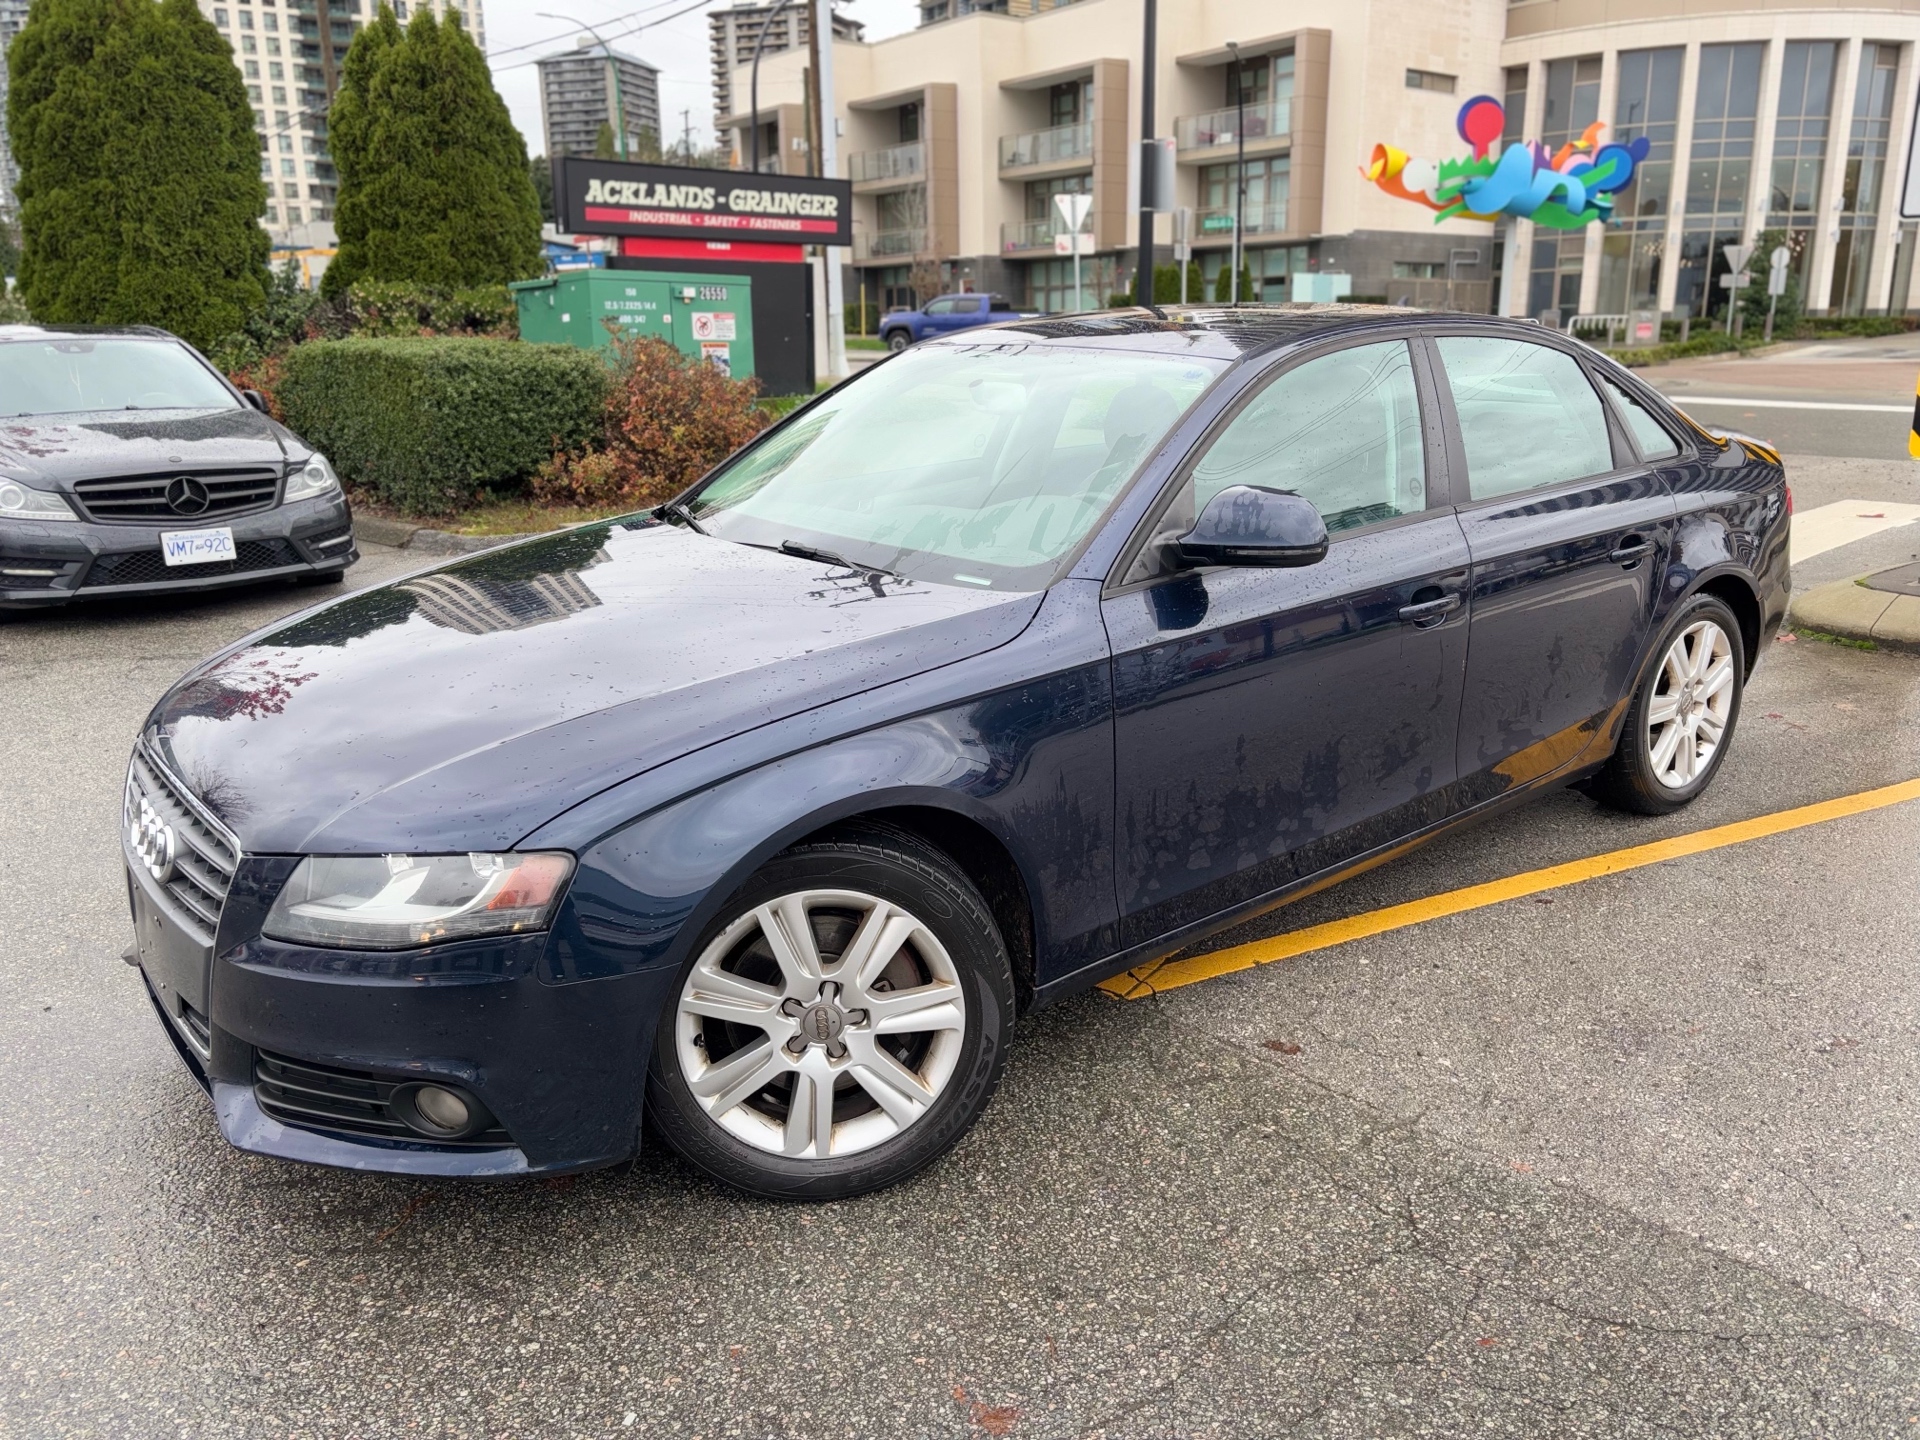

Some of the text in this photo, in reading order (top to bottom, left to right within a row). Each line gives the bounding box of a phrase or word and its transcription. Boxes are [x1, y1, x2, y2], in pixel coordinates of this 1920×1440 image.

[629, 211, 802, 231] INDUSTRIAL SAFETY FASTENERS
[699, 286, 728, 301] 26550
[166, 536, 232, 557] VM7 92C
